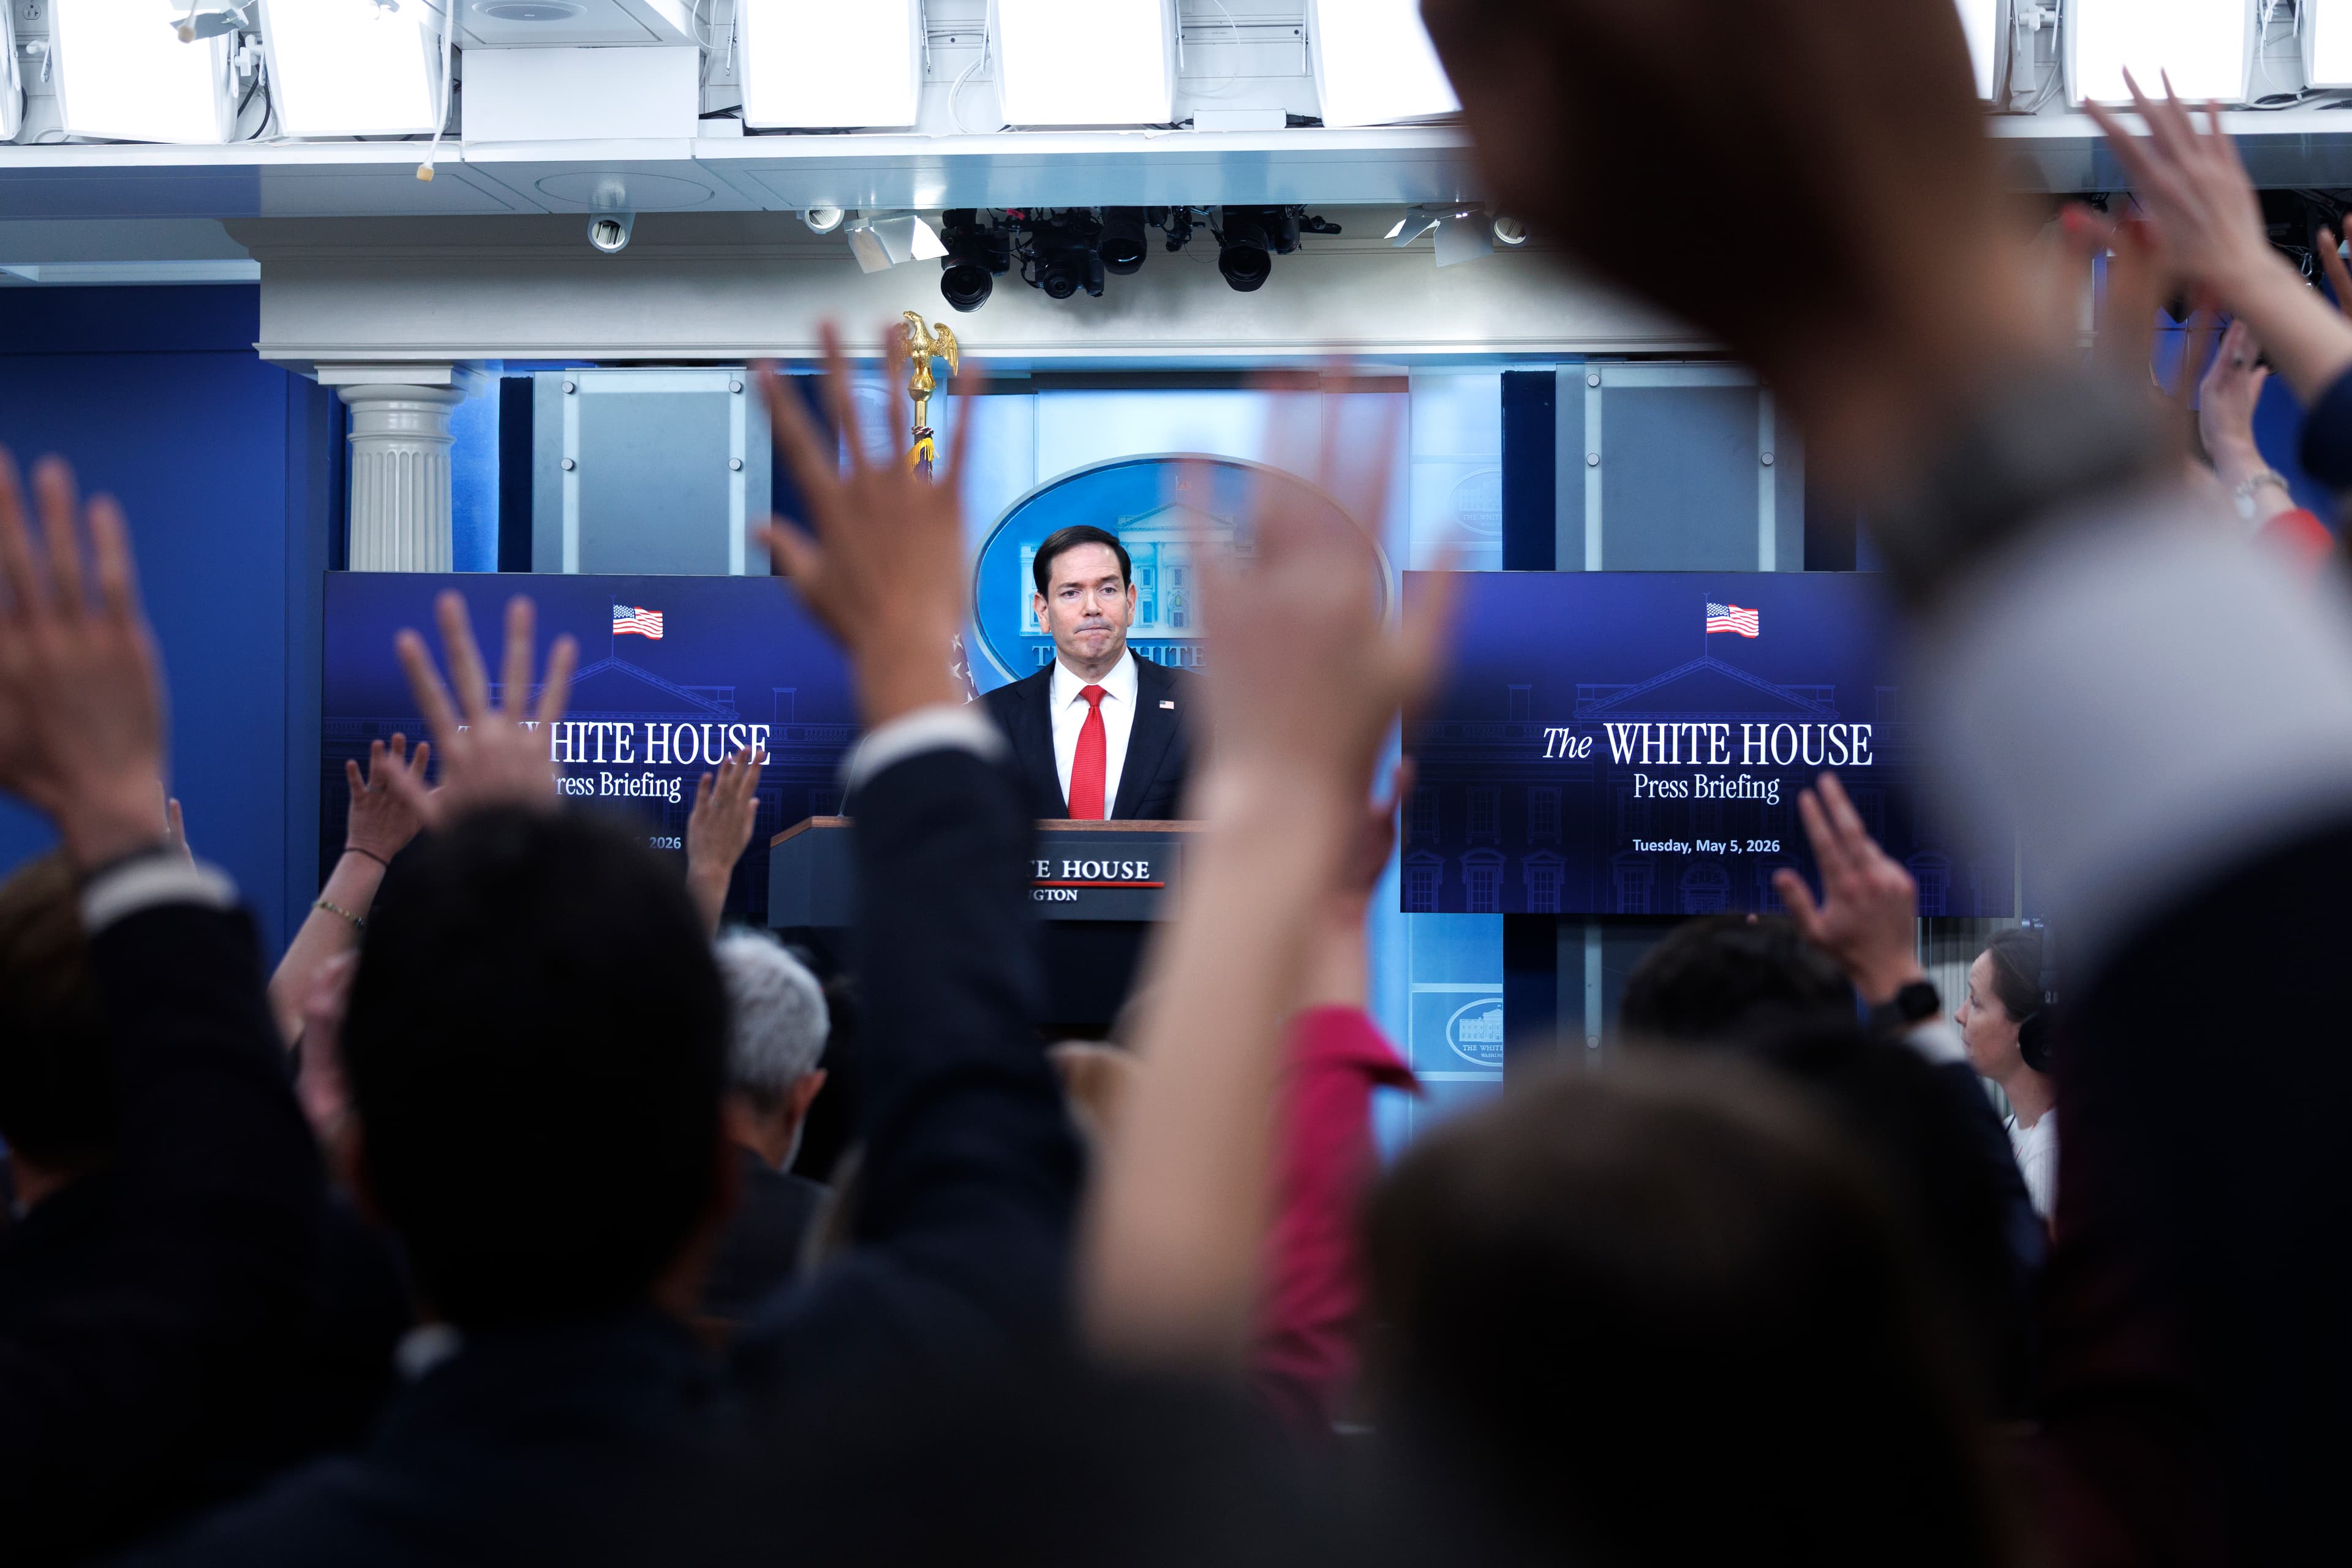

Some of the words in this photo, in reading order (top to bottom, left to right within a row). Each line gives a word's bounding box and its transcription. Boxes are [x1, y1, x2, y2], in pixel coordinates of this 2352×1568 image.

[1131, 646, 1205, 667] HITE
[644, 723, 771, 765] HOUSE
[1543, 727, 1593, 759] The
[1603, 722, 1730, 765] WHITE
[1740, 723, 1872, 766] HOUSE
[551, 773, 595, 796] ress
[599, 772, 682, 804] Briefing
[1634, 774, 1689, 798] Press
[1694, 773, 1780, 805] Briefing
[649, 837, 682, 850] 2026
[1632, 839, 1692, 854] Tuesday,
[1696, 839, 1727, 855] May
[1730, 840, 1743, 854] 5,
[1746, 839, 1780, 853] 2026
[1061, 860, 1150, 880] HOUSE
